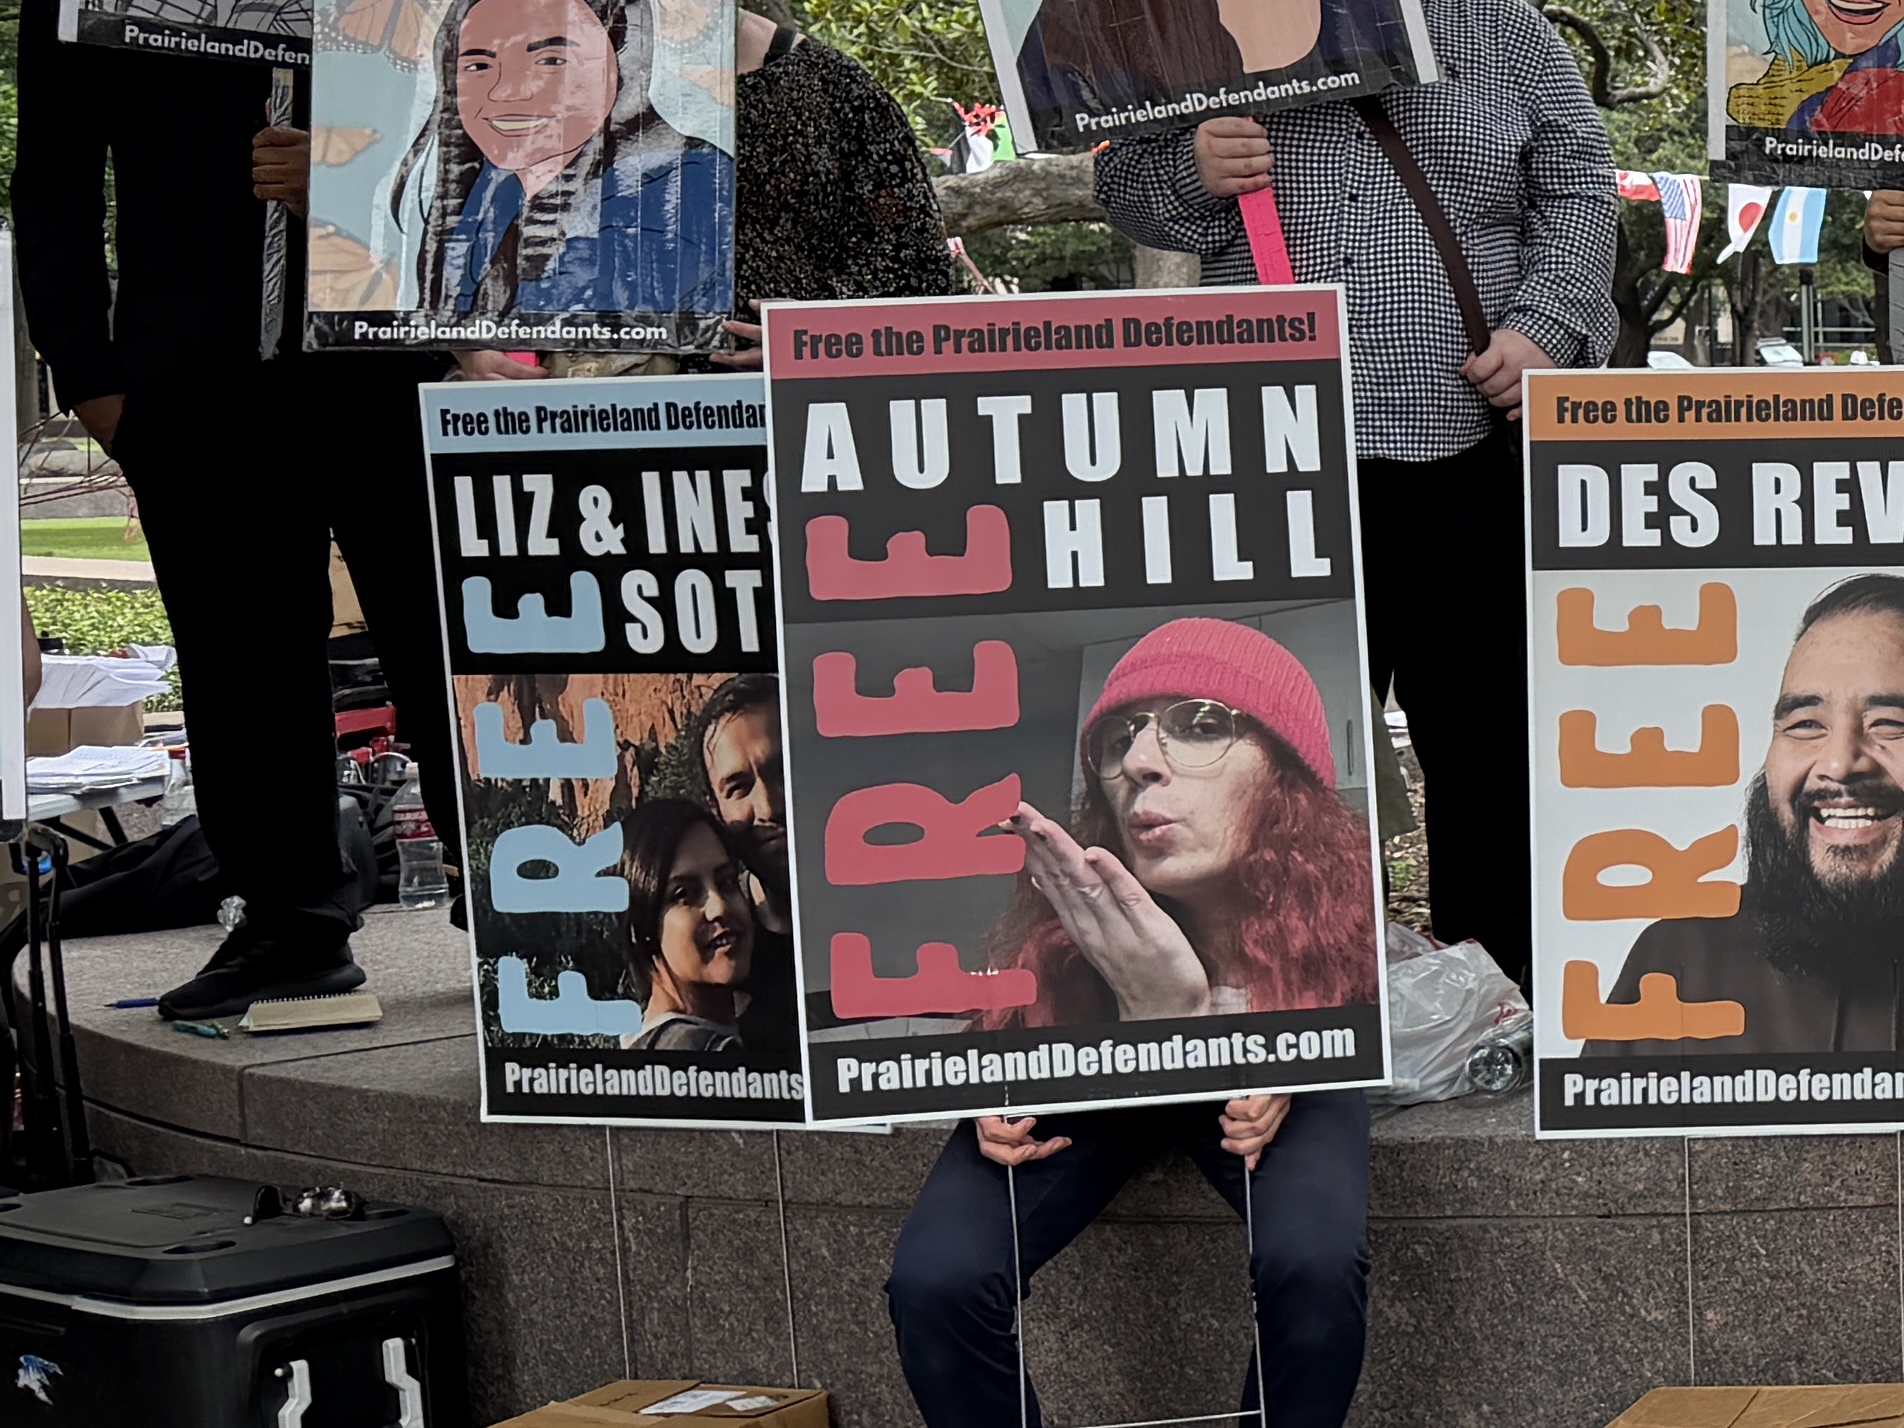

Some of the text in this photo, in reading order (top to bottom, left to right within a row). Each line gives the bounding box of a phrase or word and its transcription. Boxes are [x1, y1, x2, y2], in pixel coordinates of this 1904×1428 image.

[1074, 72, 1360, 133] PrairielandDefendants.com
[354, 320, 667, 341] PrairielandDefendants.com
[793, 312, 1317, 361] Free the Prairieland Defendants!
[440, 408, 489, 437] Free
[494, 406, 531, 435] the
[535, 402, 661, 434] Prairieland
[801, 385, 1321, 493] AUTUMN
[1556, 396, 1617, 424] Free
[1624, 396, 1669, 424] the
[1677, 393, 1834, 423] Prairieland
[454, 470, 769, 557] LIZ & INE
[1043, 490, 1332, 589] HILL
[1557, 462, 1720, 548] DES
[461, 570, 642, 1034] FREE
[805, 504, 1037, 1019] FREE
[1556, 581, 1745, 1040] FREE
[837, 1026, 1355, 1093] PrairielandDefendants.com
